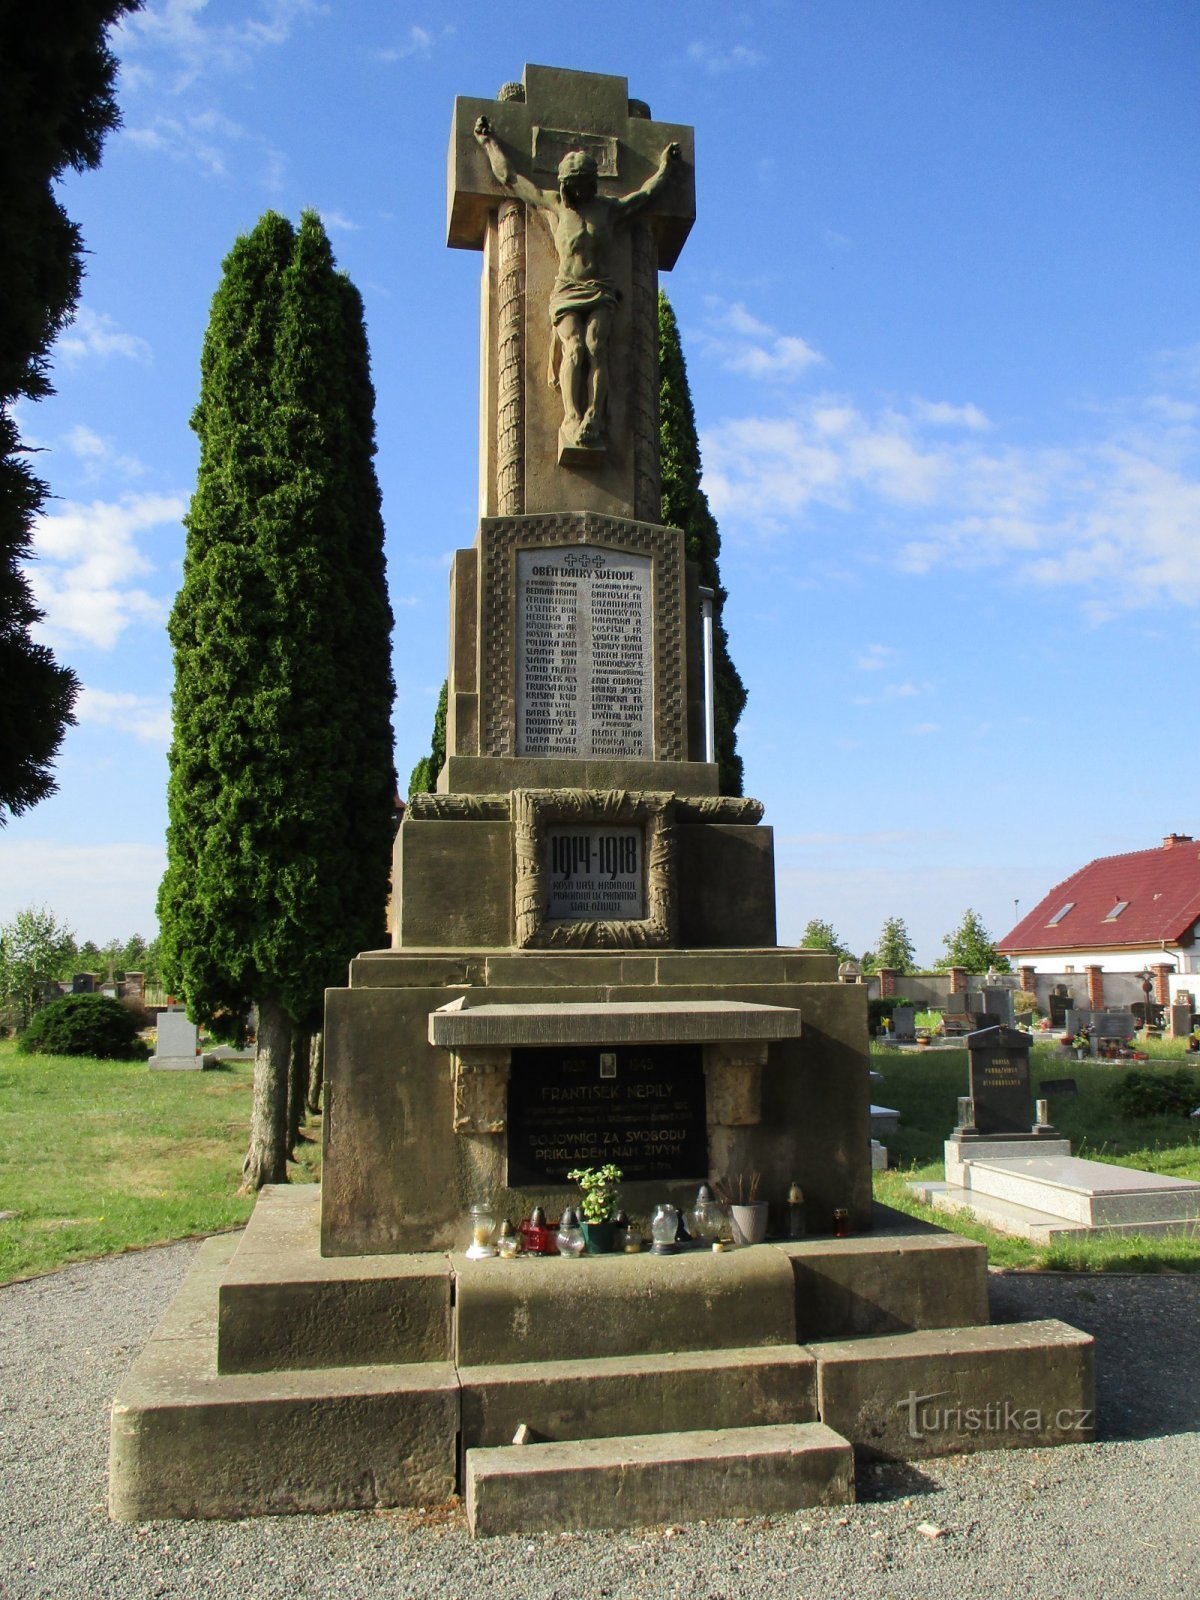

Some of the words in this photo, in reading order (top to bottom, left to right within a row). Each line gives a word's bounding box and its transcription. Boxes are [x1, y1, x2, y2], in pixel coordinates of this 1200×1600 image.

[552, 836, 636, 880] 1914-1918
[603, 1132, 620, 1144] ZA
[625, 1129, 686, 1143] SVOBODU
